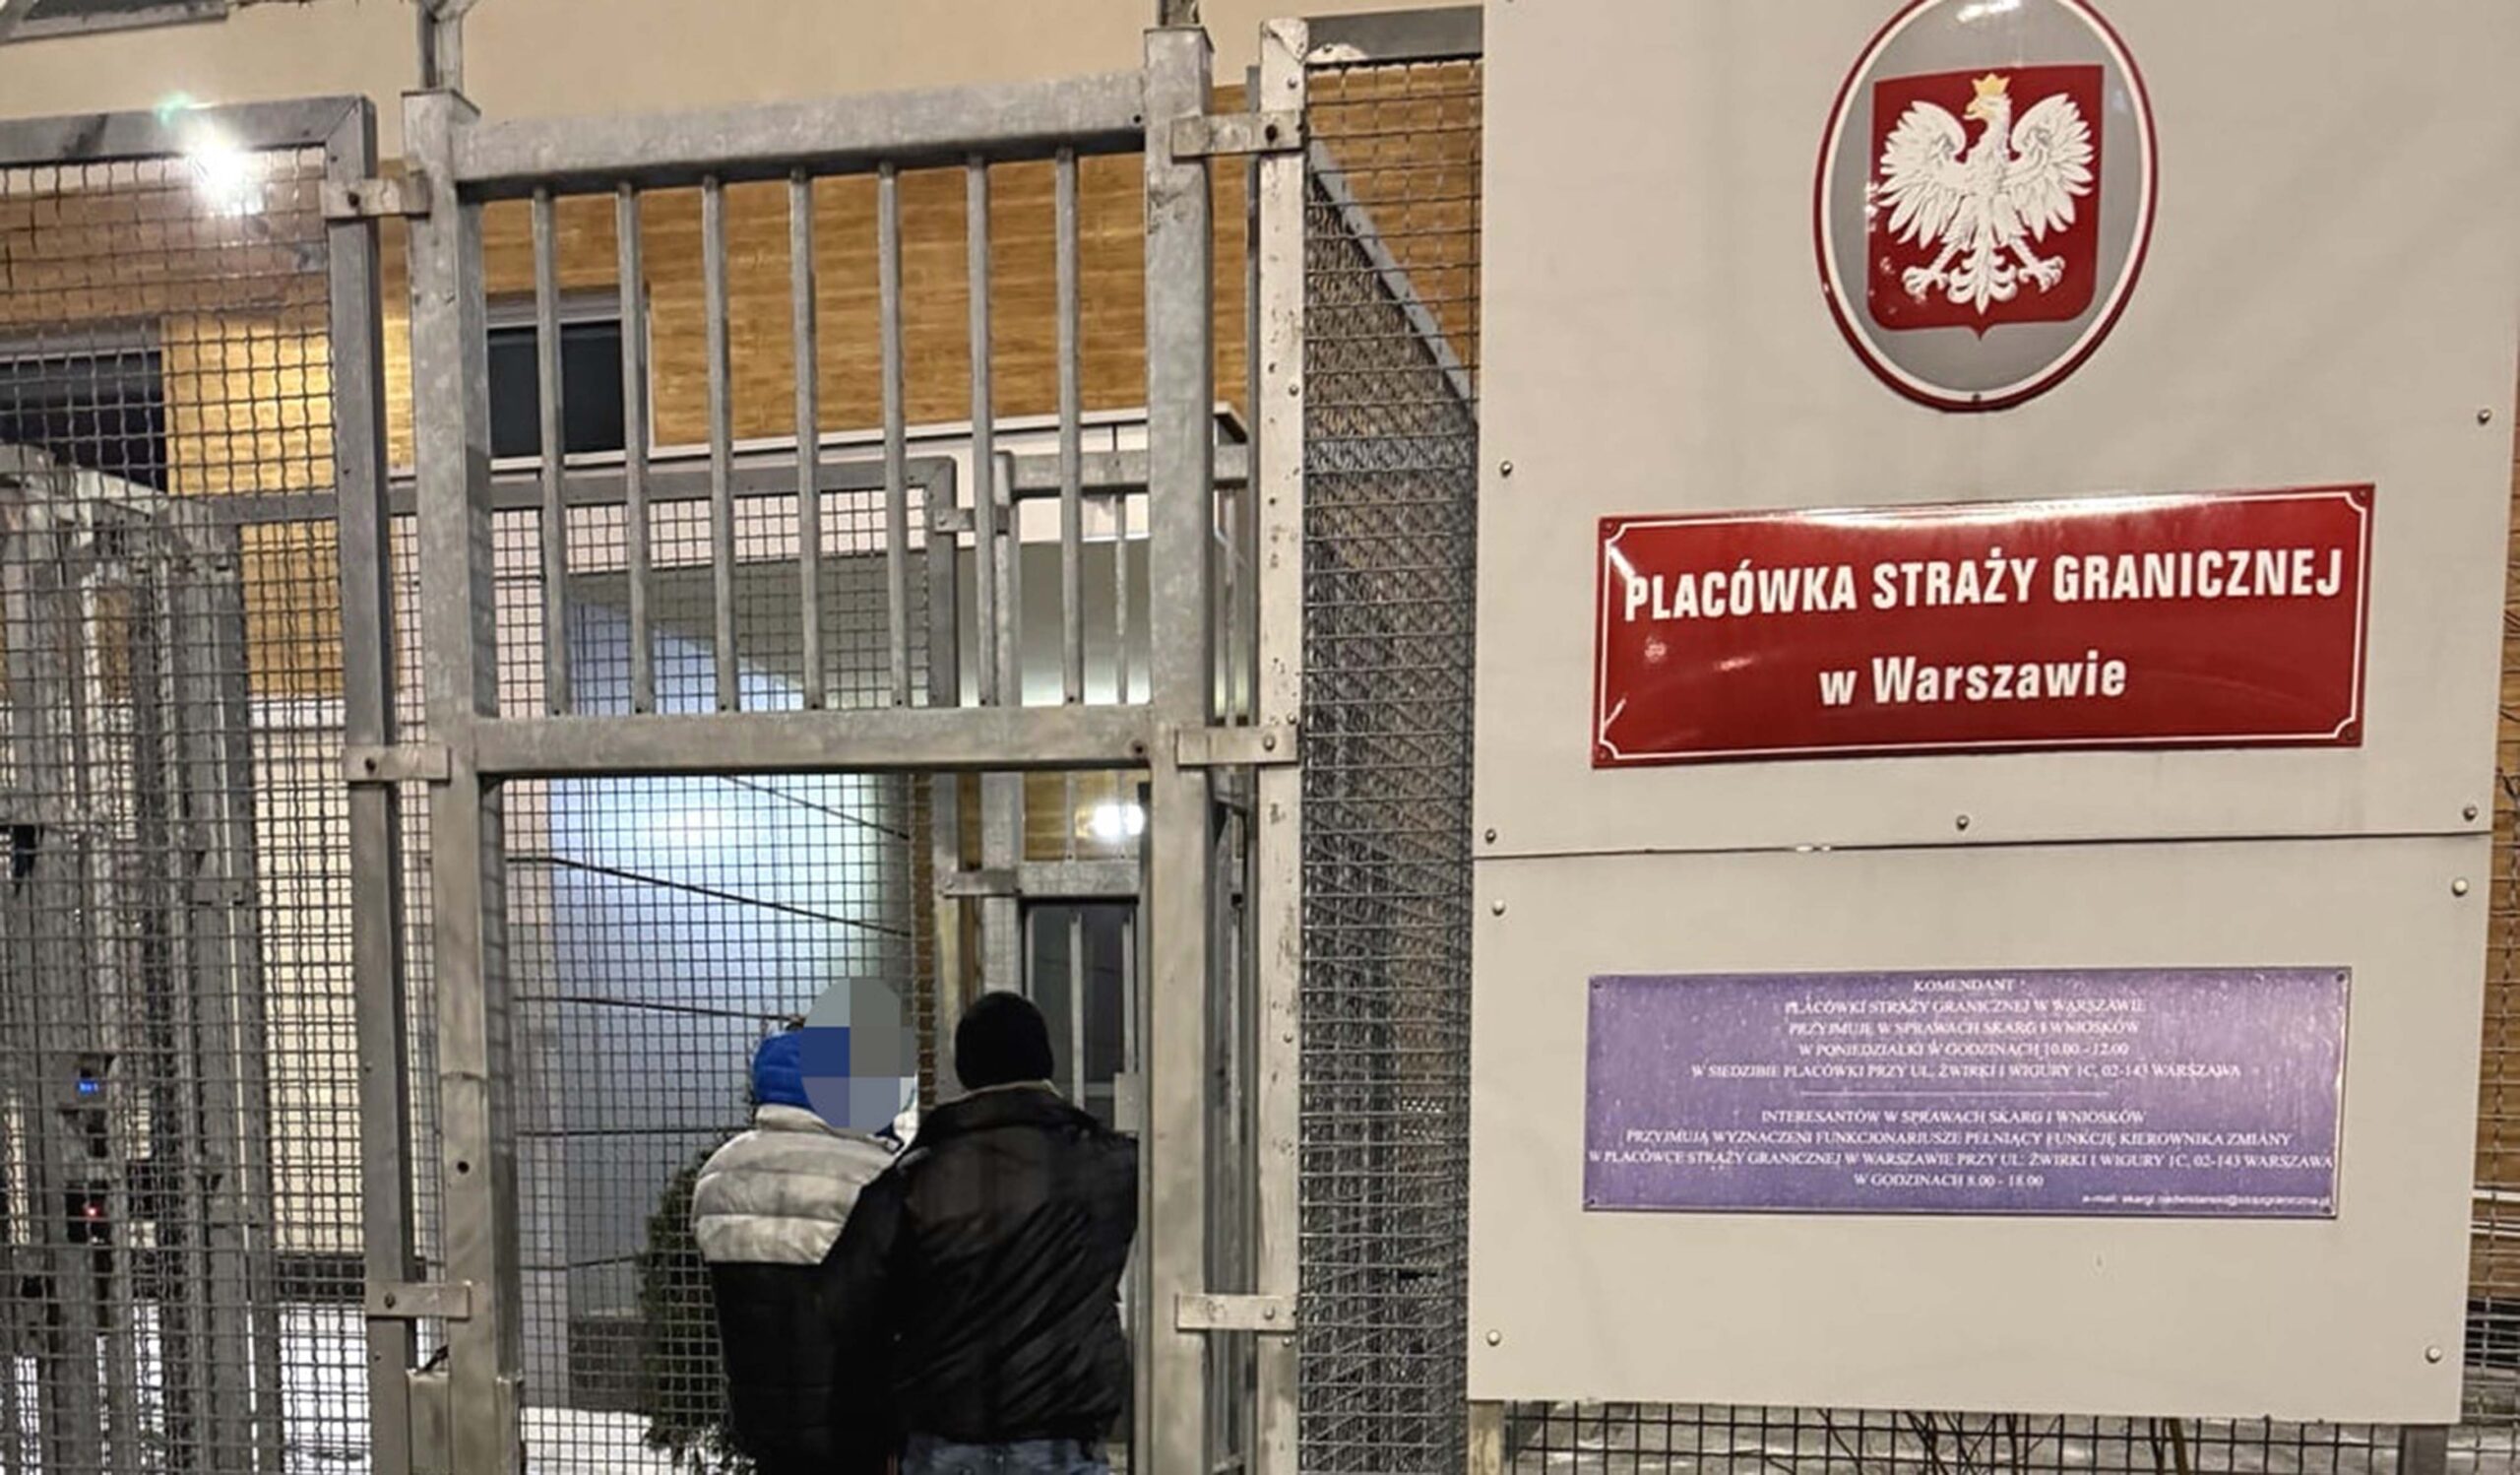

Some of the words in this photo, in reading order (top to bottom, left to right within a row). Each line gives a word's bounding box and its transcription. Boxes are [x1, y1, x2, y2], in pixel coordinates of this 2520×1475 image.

[1624, 558, 1858, 621] PLACÓWKA
[1872, 545, 2038, 610] STRAŻY
[2052, 548, 2343, 602] GRANICZNEJ
[1819, 669, 1858, 706] w
[1871, 650, 2126, 704] Warszawie
[1913, 978, 2015, 993] KOMENDANT
[1785, 998, 1864, 1014] PLACÓWKI
[1869, 998, 1928, 1014] STRAŻY
[1931, 998, 2030, 1014] GRANICZNEJ
[2033, 998, 2047, 1012] W
[2050, 998, 2146, 1013] WARSZAWIE
[1789, 1021, 1871, 1035] PRZYJMUJE
[1876, 1021, 1891, 1035] W
[1895, 1020, 1980, 1034] SPRAWACH
[1983, 1020, 2035, 1034] SKARG
[2049, 1018, 2140, 1034] WNIOSKÓW
[1798, 1044, 1813, 1057] W
[1944, 1042, 2040, 1057] GODZINACH
[1691, 1063, 1705, 1078] W
[1708, 1063, 1777, 1078] SIEDZIBIE
[1783, 1062, 1865, 1079] PLACÓWKI
[1867, 1063, 1908, 1078] PRZY
[1938, 1061, 1995, 1078] ŻWIRKI
[2008, 1063, 2071, 1078] WIGURY
[2150, 1062, 2241, 1078] WARSZAWA
[1762, 1109, 1879, 1123] INTERESANTÓW
[1883, 1110, 1898, 1123] W
[1901, 1110, 1985, 1124] SPRAWACH
[1988, 1110, 2044, 1124] SKARG
[2055, 1109, 2146, 1123] WNIOSKÓW
[1626, 1129, 1709, 1145] PRZYJMUJĄ
[1712, 1130, 1813, 1144] WYZNACZENI
[1816, 1131, 1962, 1145] FUNKCJONARIUSZE
[2120, 1131, 2225, 1147] KIEROWNIKA
[2227, 1132, 2292, 1146] ZMIANY
[1588, 1150, 1602, 1162] W
[1604, 1149, 1685, 1163] PLACÓWCE
[1687, 1150, 1745, 1164] STRAŻY
[1747, 1151, 1842, 1165] GRANICZNEJ
[1845, 1152, 1859, 1165] W
[1862, 1151, 1954, 1166] WARSZAWIE
[1957, 1152, 1998, 1166] PRZY
[2029, 1151, 2087, 1166] ŻWIRKI
[2101, 1153, 2165, 1167] WIGURY
[2192, 1154, 2241, 1168] 02-143
[2242, 1154, 2333, 1169] WARSZAWA
[1854, 1173, 1869, 1185] W
[1871, 1173, 1965, 1186] GODZINACH
